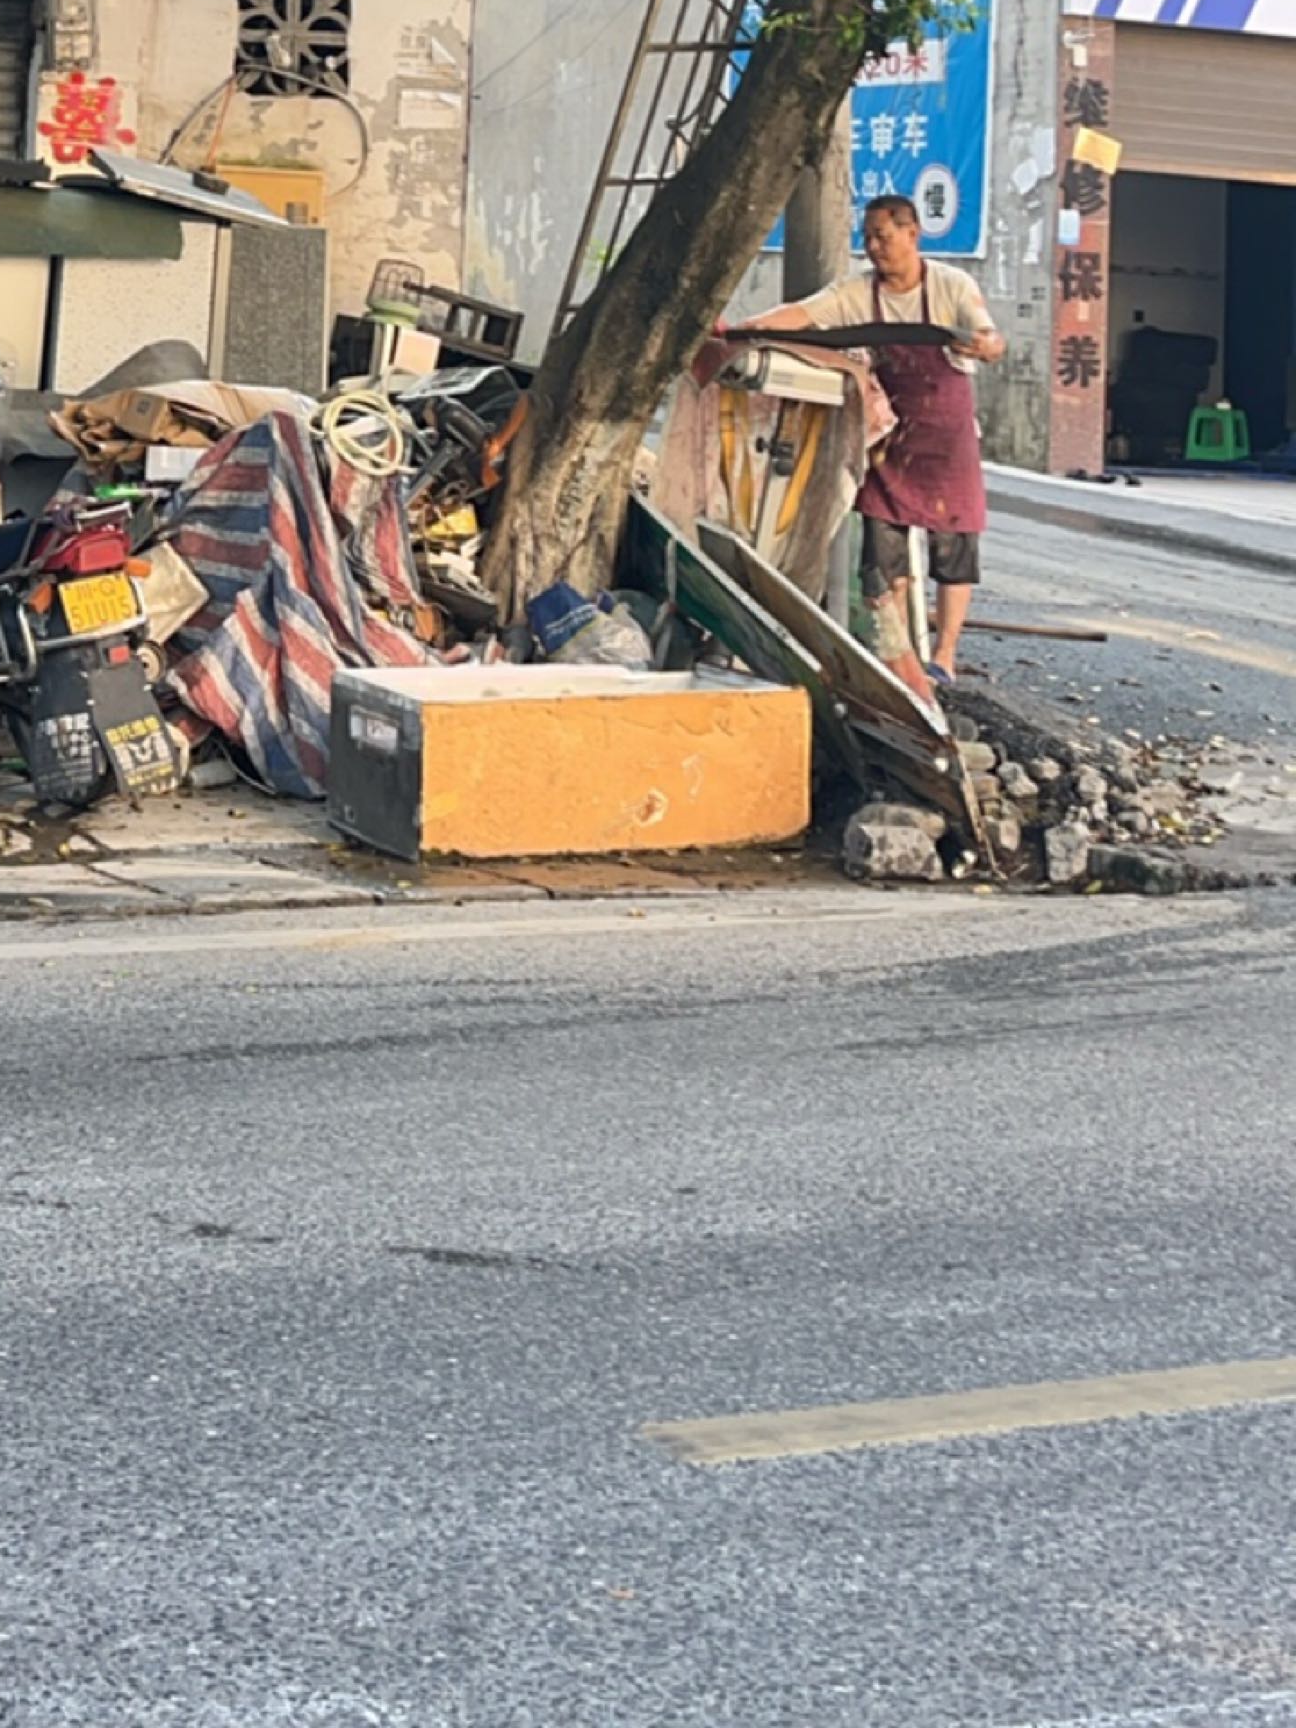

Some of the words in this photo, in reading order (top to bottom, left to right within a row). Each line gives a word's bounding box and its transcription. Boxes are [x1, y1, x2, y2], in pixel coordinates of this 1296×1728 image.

[925, 181, 946, 219] 慢
[1057, 75, 1110, 389] 维修保养
